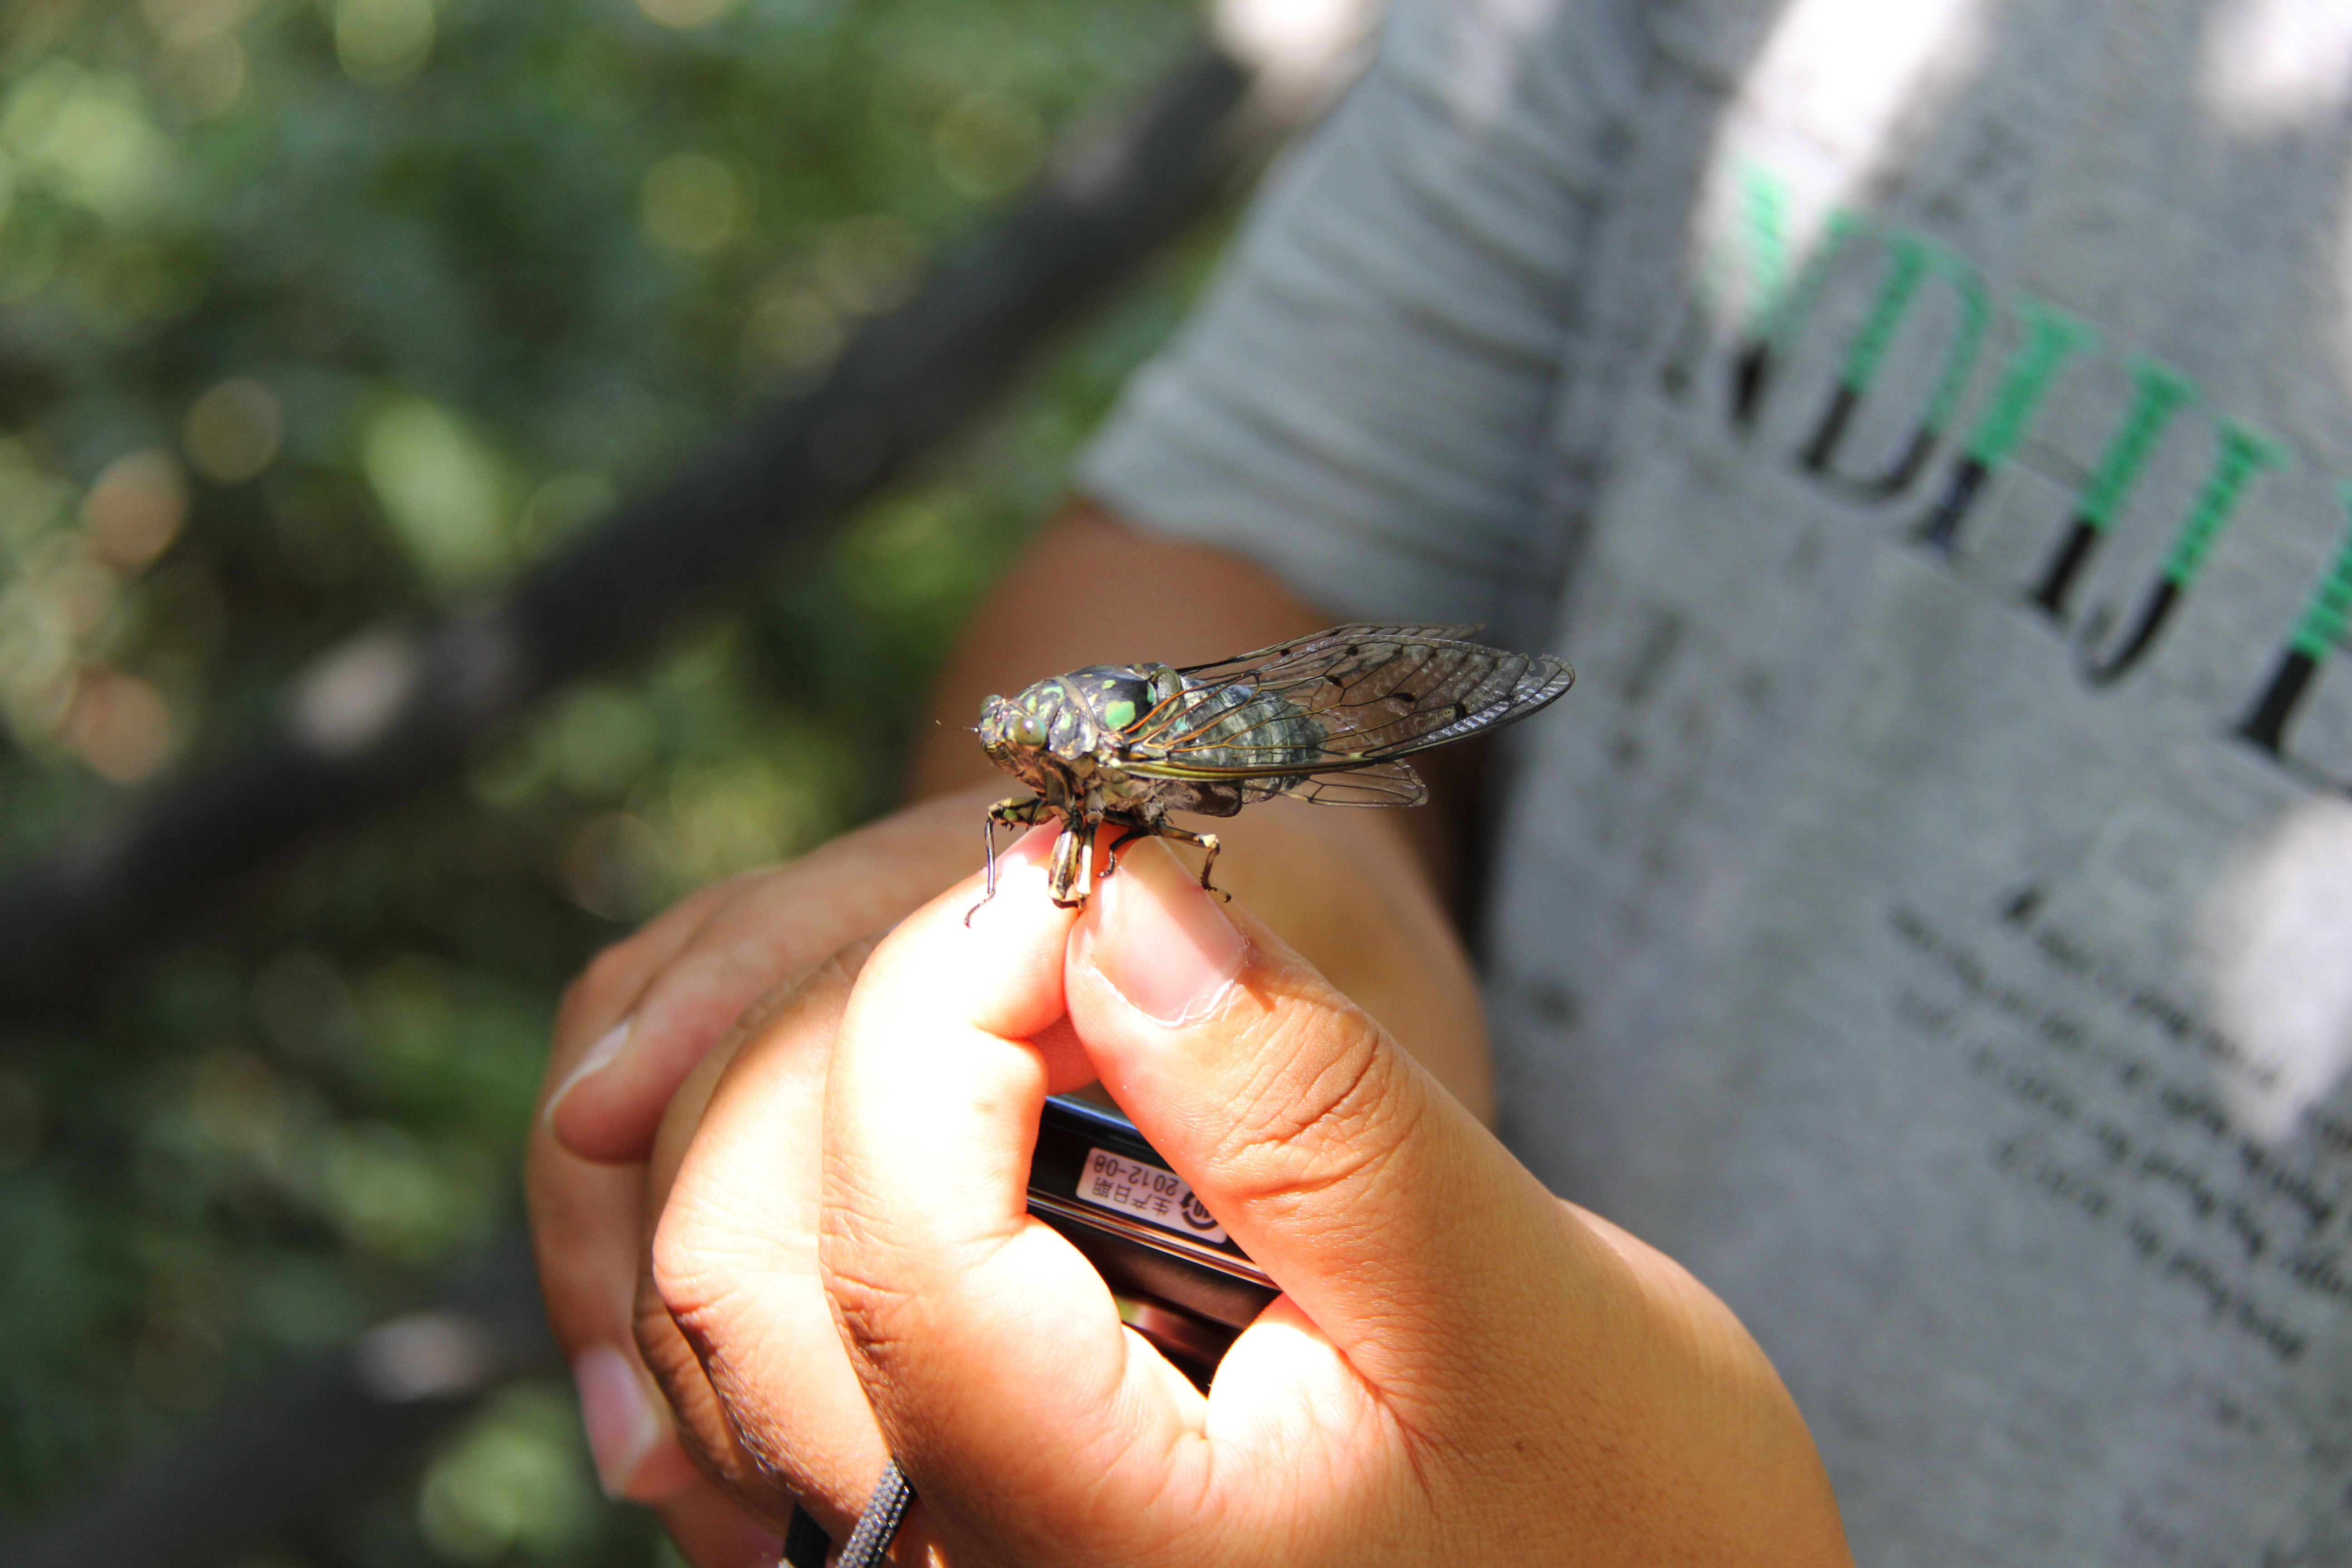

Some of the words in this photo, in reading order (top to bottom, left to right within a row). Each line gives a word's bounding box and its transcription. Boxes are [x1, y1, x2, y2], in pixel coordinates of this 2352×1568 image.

[1093, 1155, 1179, 1196] 2012-08
[1093, 1177, 1173, 1217] 生产日期
